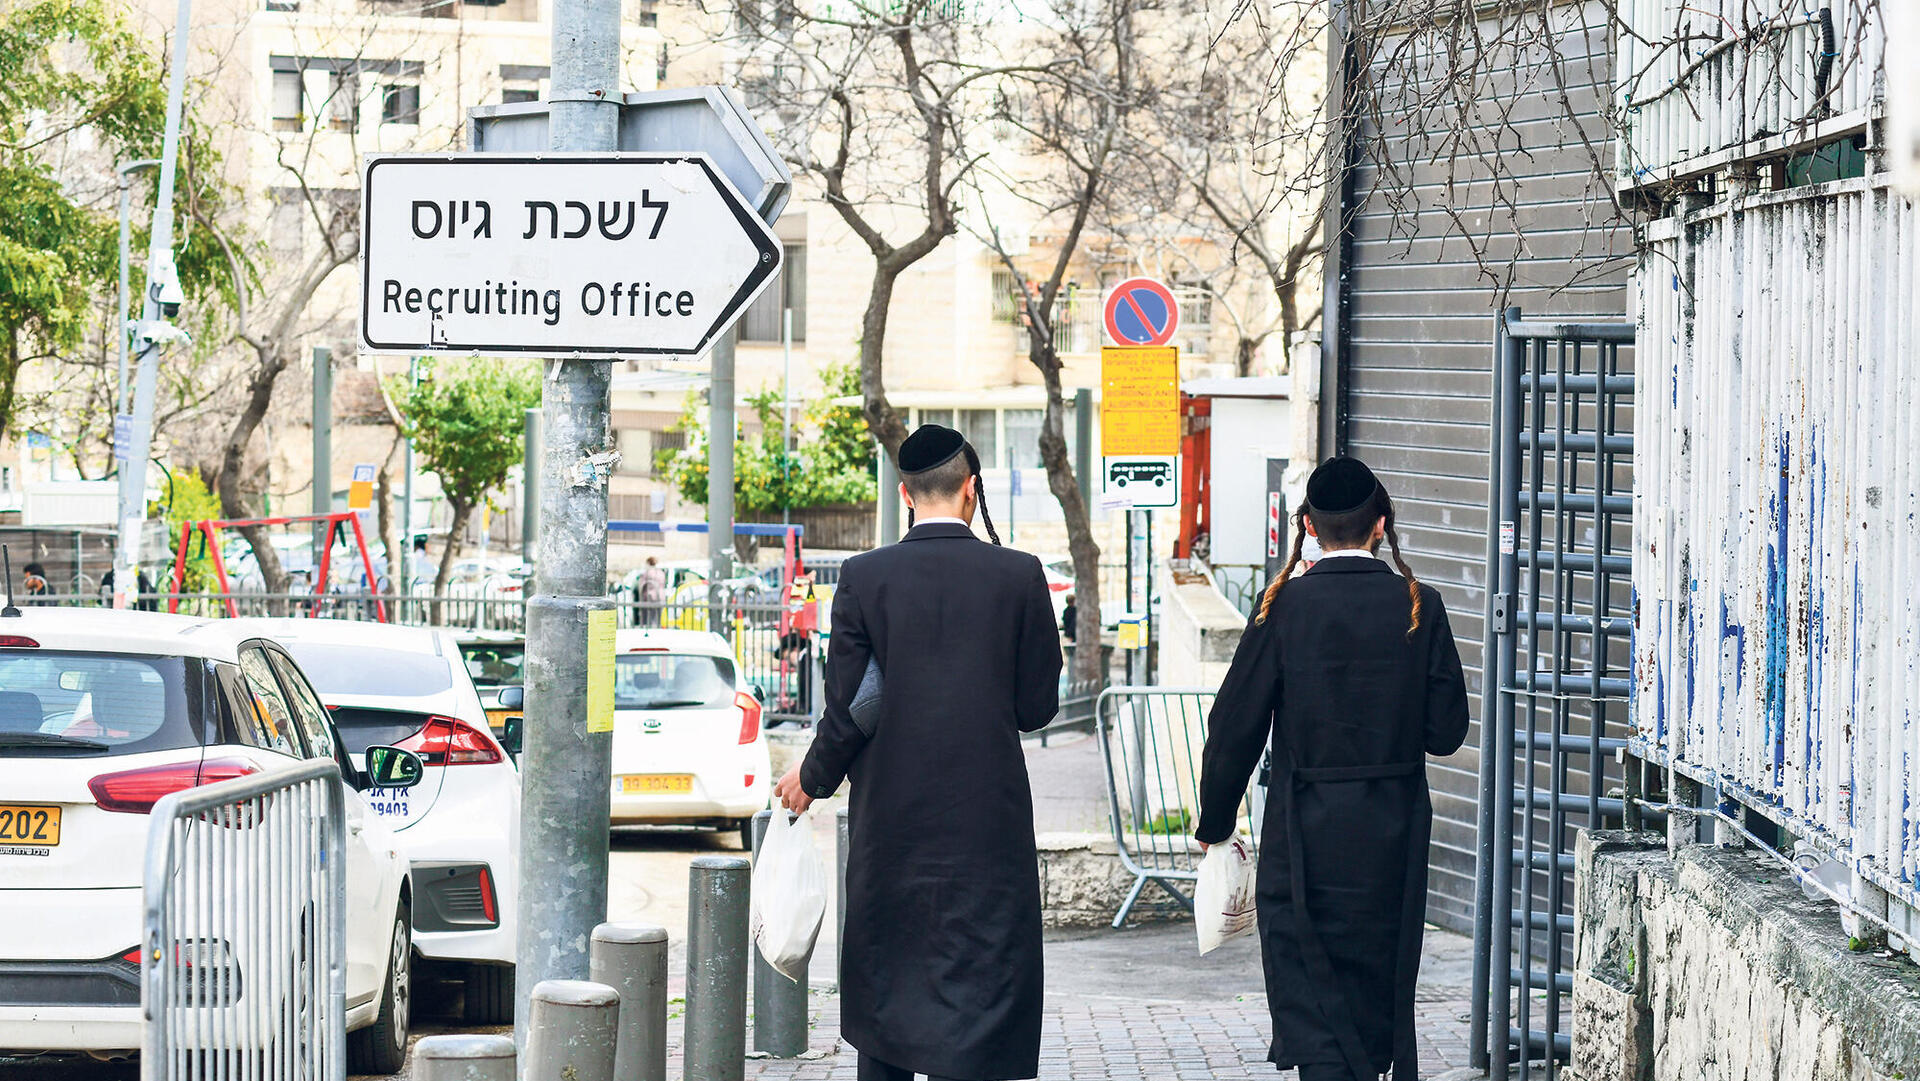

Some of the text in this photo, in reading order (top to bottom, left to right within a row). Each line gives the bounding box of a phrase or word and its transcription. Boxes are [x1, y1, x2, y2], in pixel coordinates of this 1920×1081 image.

[411, 189, 669, 241] לשכת גיוס
[383, 279, 695, 326] Recruiting Office
[1152, 400, 1172, 408] ONLY
[0, 810, 48, 840] 202
